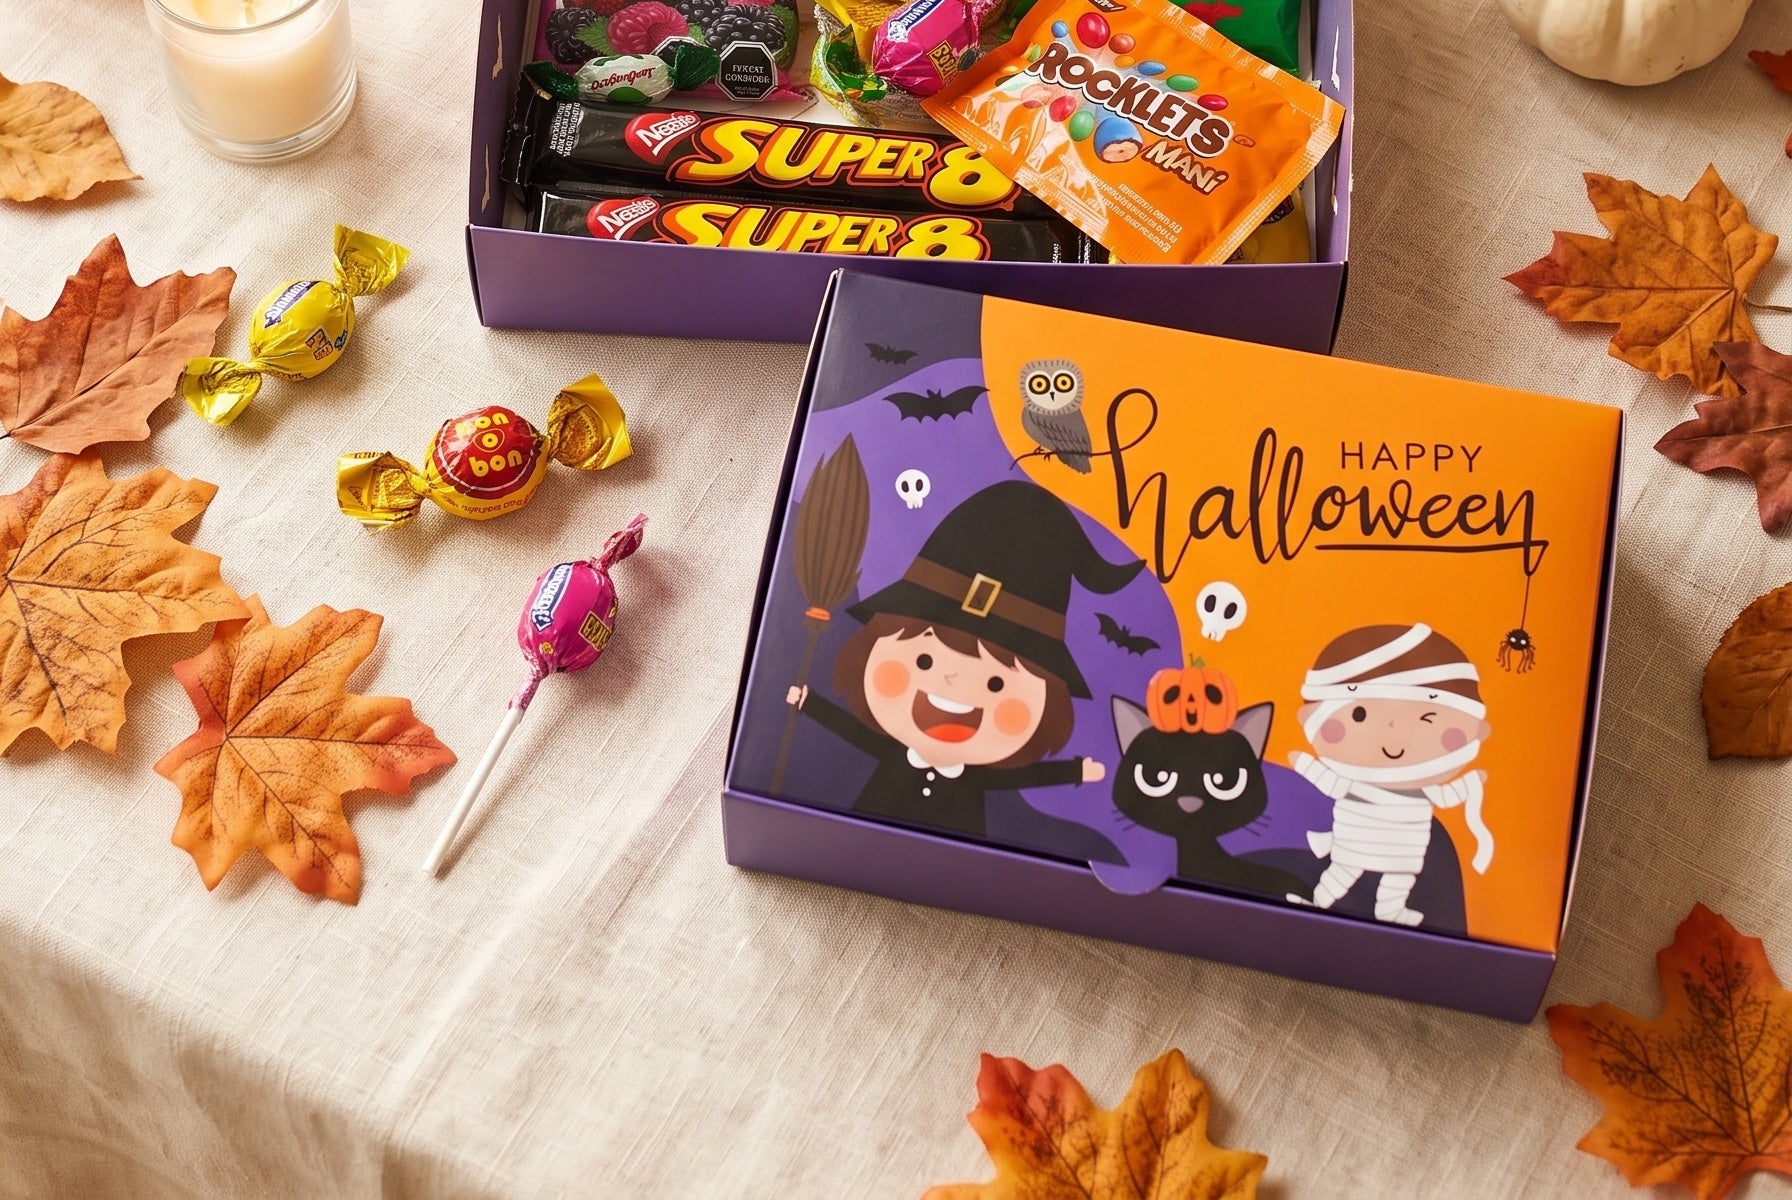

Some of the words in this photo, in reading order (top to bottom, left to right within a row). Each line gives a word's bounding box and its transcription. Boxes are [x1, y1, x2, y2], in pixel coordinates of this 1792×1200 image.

[1027, 42, 1231, 157] ROCKLETS
[667, 117, 937, 185] SUPER
[927, 144, 1016, 208] 8
[656, 201, 901, 254] SUPER
[894, 215, 986, 261] 8
[468, 449, 523, 478] bon
[1105, 388, 1549, 584] halloween
[1340, 441, 1483, 473] HAPPY
